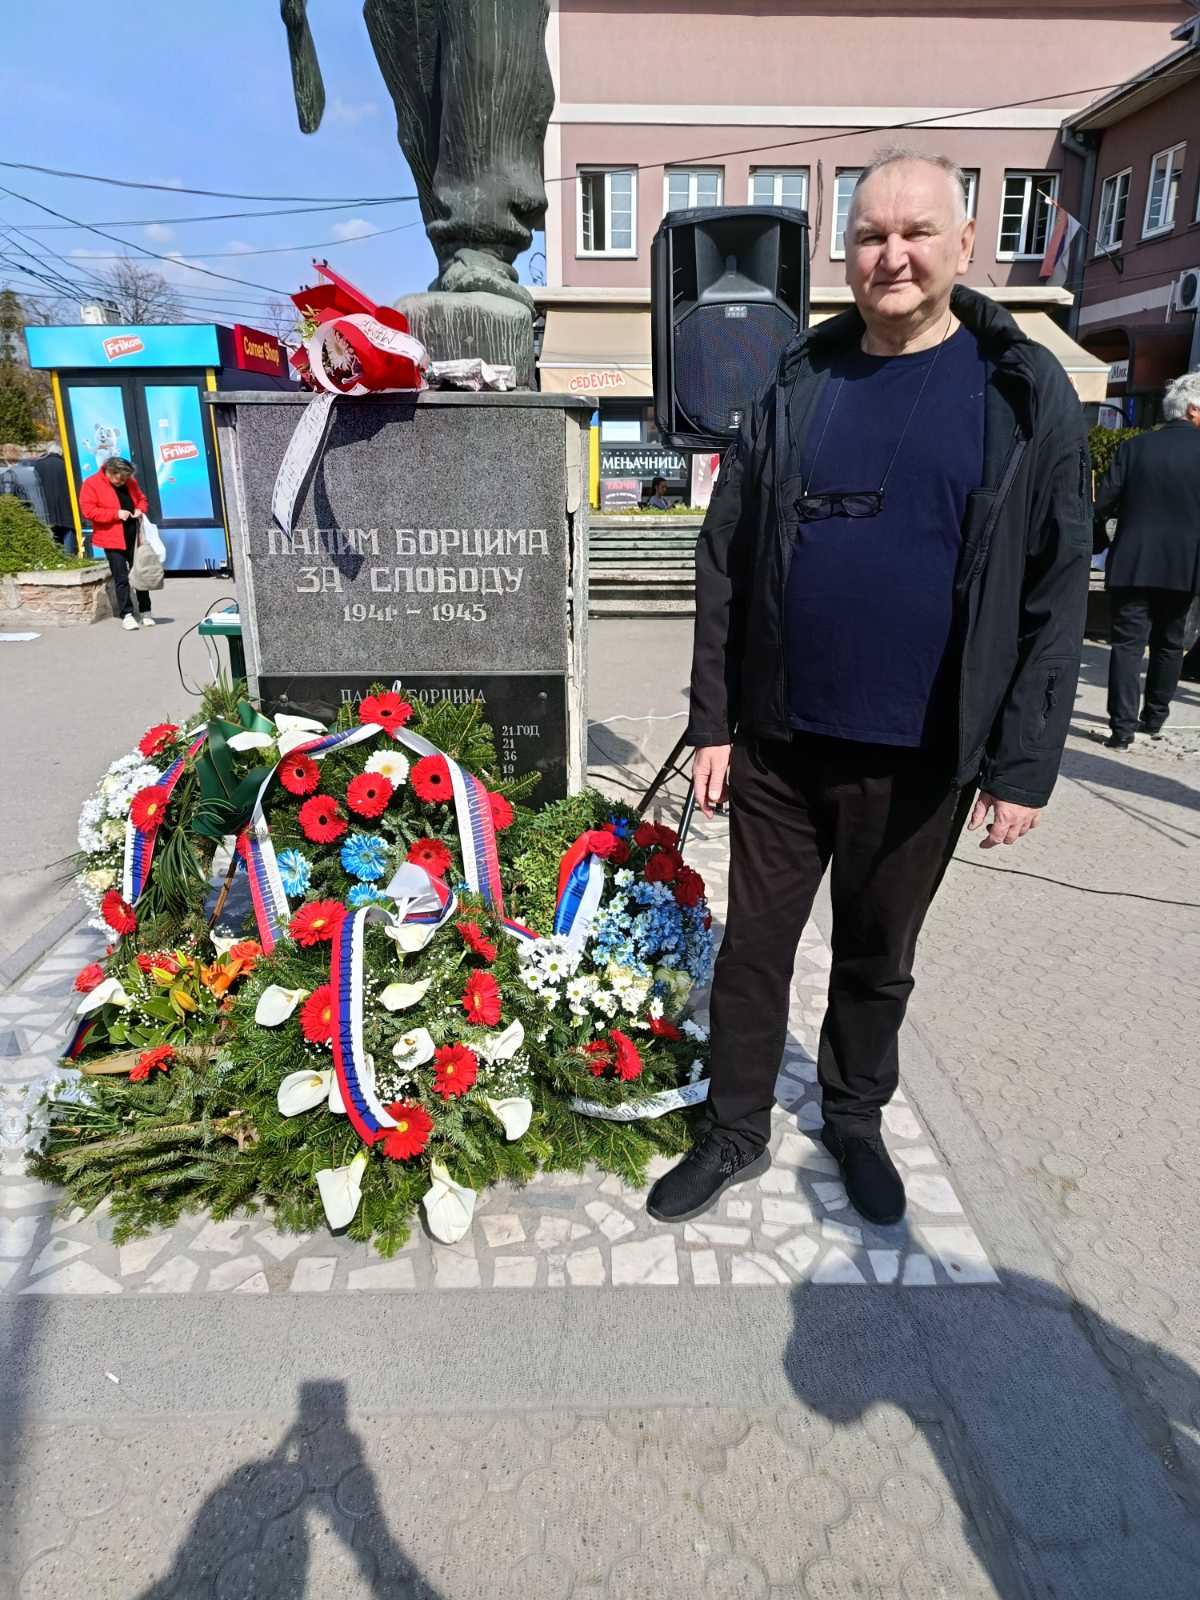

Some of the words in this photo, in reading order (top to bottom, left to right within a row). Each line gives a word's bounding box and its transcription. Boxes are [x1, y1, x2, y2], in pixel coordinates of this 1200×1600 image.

[243, 336, 264, 359] Corner
[264, 342, 280, 367] Shop
[570, 373, 624, 391] CEDEVITA
[602, 456, 687, 470] МЕЊАЧНИЦА
[267, 528, 380, 555] ПАЛИМ
[395, 528, 550, 558] БОРЦИМА
[297, 566, 344, 593] ЗА
[370, 566, 525, 596] СЛОБОДУ
[432, 603, 487, 622] 1945
[502, 738, 515, 749] 21
[503, 751, 517, 761] 36
[502, 764, 515, 774] 19
